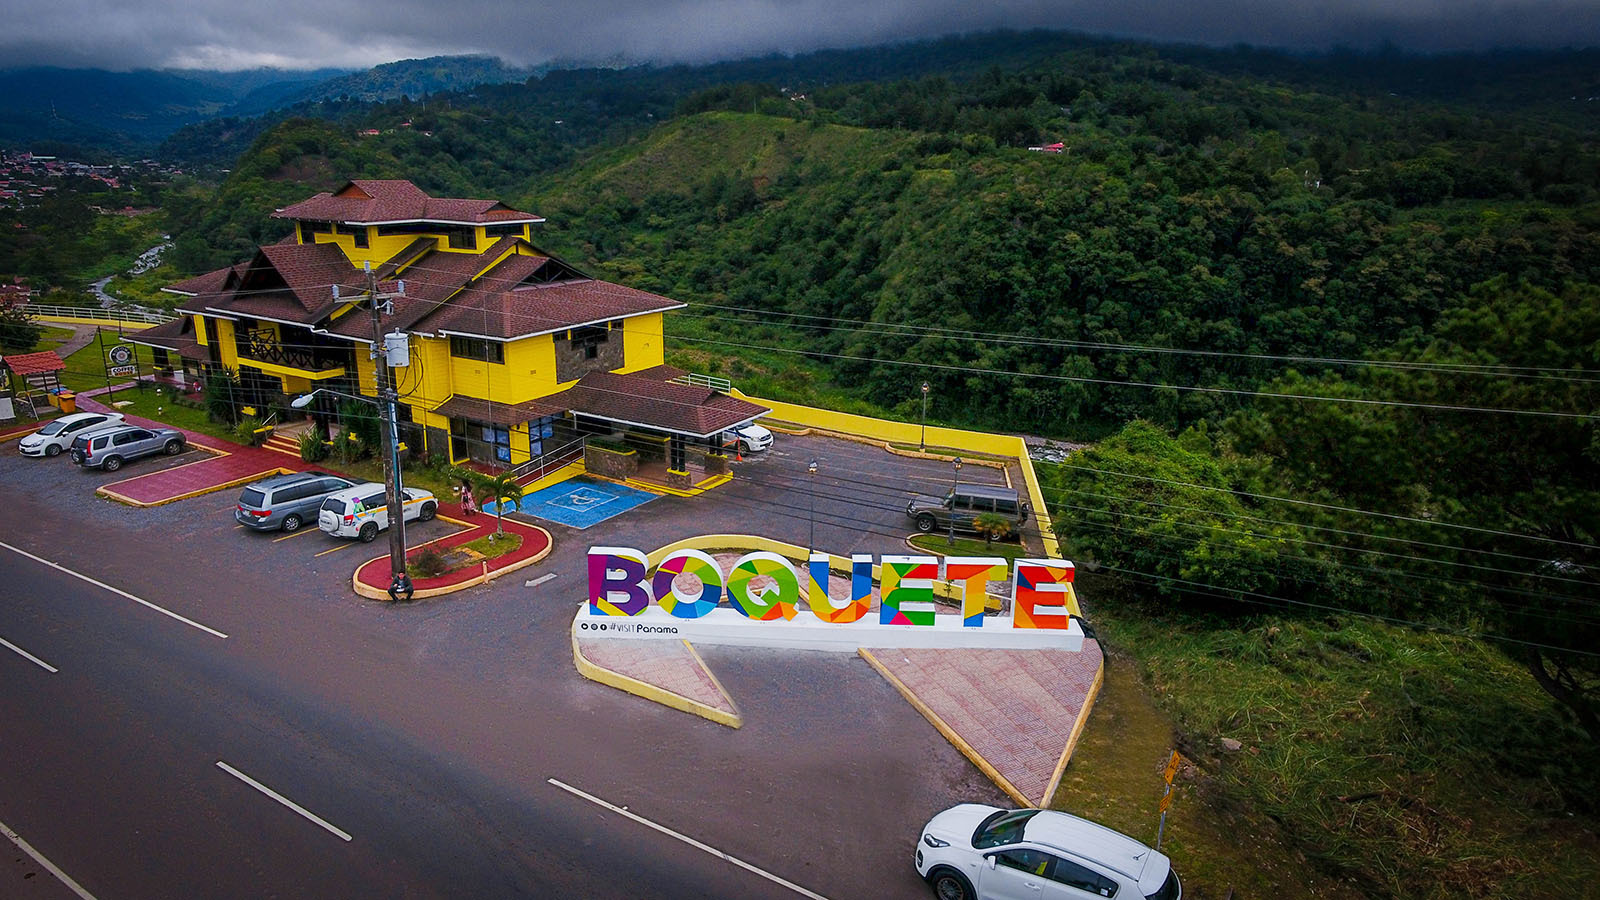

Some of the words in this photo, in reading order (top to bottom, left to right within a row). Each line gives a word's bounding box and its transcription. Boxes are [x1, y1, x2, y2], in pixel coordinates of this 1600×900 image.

[587, 546, 1075, 630] BOQUETE
[610, 623, 635, 632] #VISIT
[637, 624, 678, 633] Panama
